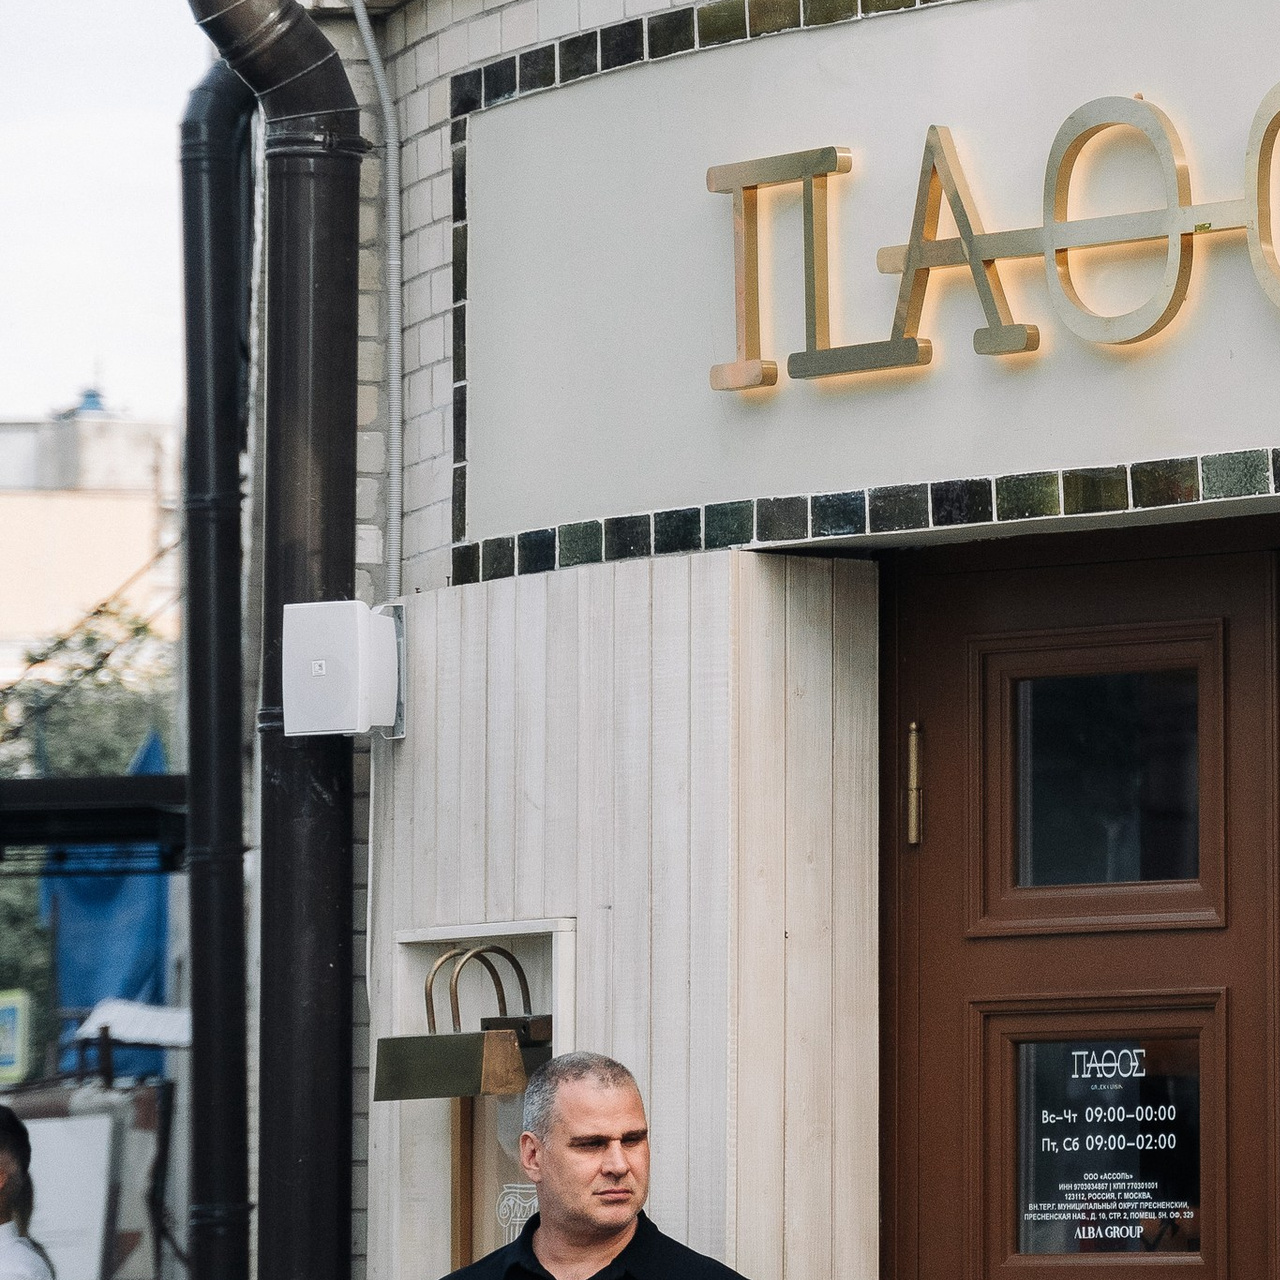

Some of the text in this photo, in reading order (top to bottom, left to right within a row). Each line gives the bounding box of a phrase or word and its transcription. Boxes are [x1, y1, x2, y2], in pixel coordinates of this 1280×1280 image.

[1041, 1138, 1059, 1153] Пт,
[1062, 1137, 1080, 1151] Сб
[1058, 1183, 1073, 1191] ИНН
[1064, 1193, 1087, 1201] 123112,
[1123, 1192, 1153, 1200] МОСКВА,
[1057, 1201, 1117, 1211] МУНИЦИПАЛЬНЫЙ
[1024, 1213, 1071, 1221] ПРЕСНЕНСКАЯ
[1098, 1212, 1108, 1220] 10,
[1108, 1212, 1122, 1220] СТР.
[1105, 1225, 1144, 1238] GROUP
